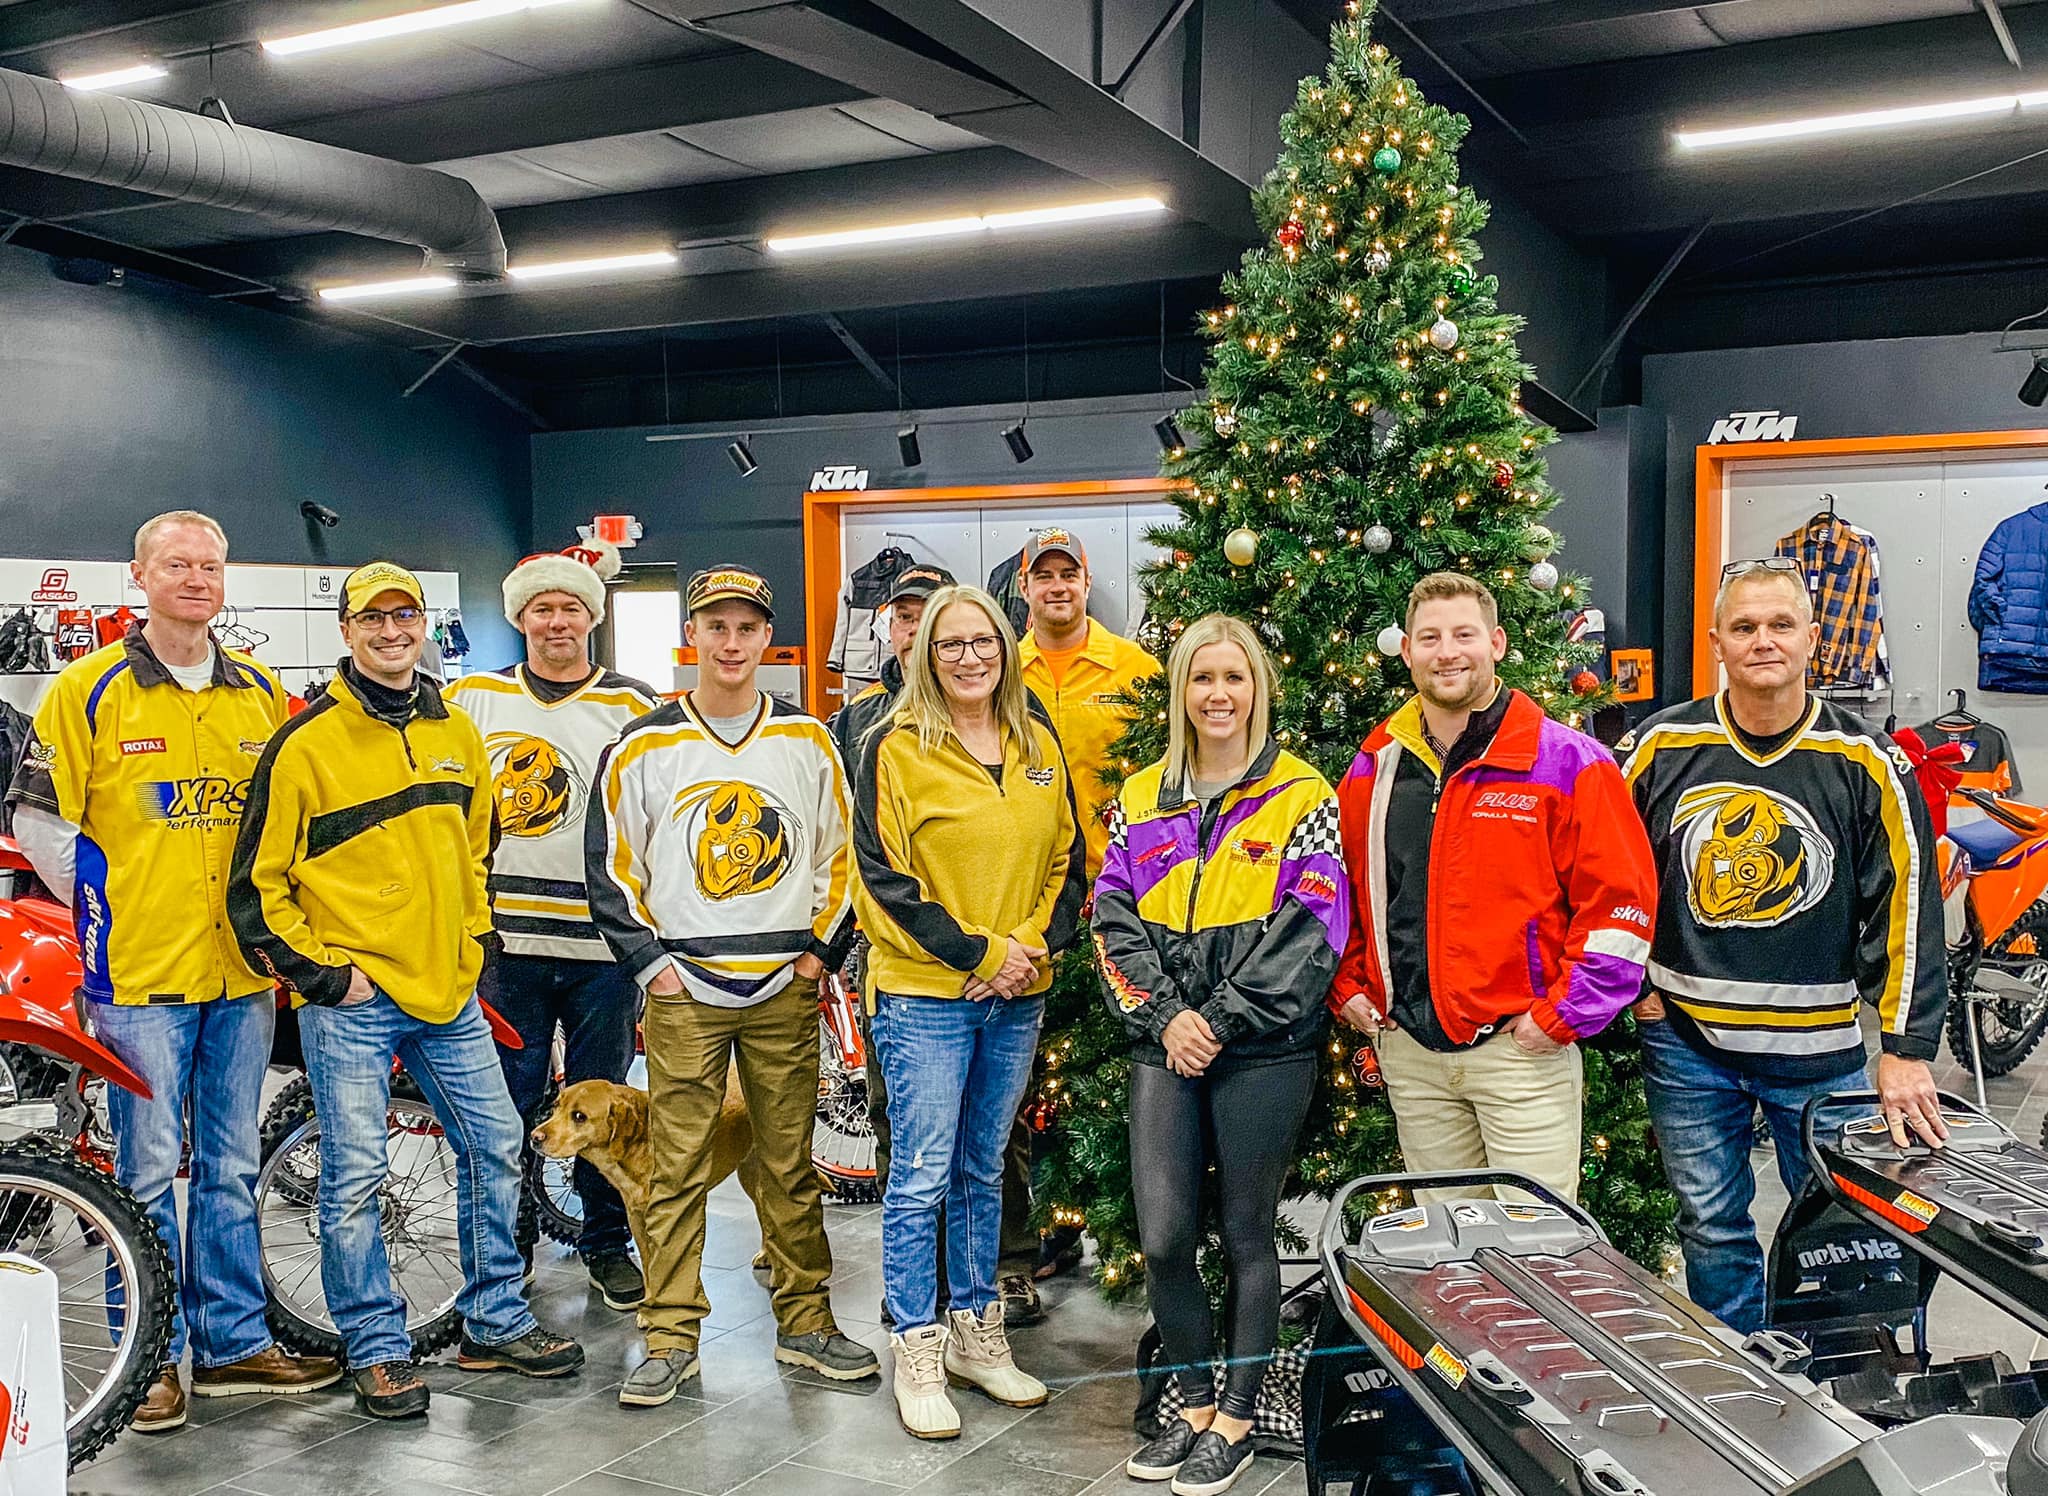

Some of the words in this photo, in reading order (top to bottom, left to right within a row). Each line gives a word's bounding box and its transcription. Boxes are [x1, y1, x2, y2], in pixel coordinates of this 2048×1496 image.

[1706, 410, 1798, 443] KTM
[809, 465, 869, 491] KTM
[32, 591, 77, 601] GASGAS
[122, 741, 165, 754] ROTAX
[1475, 791, 1538, 811] PLUS
